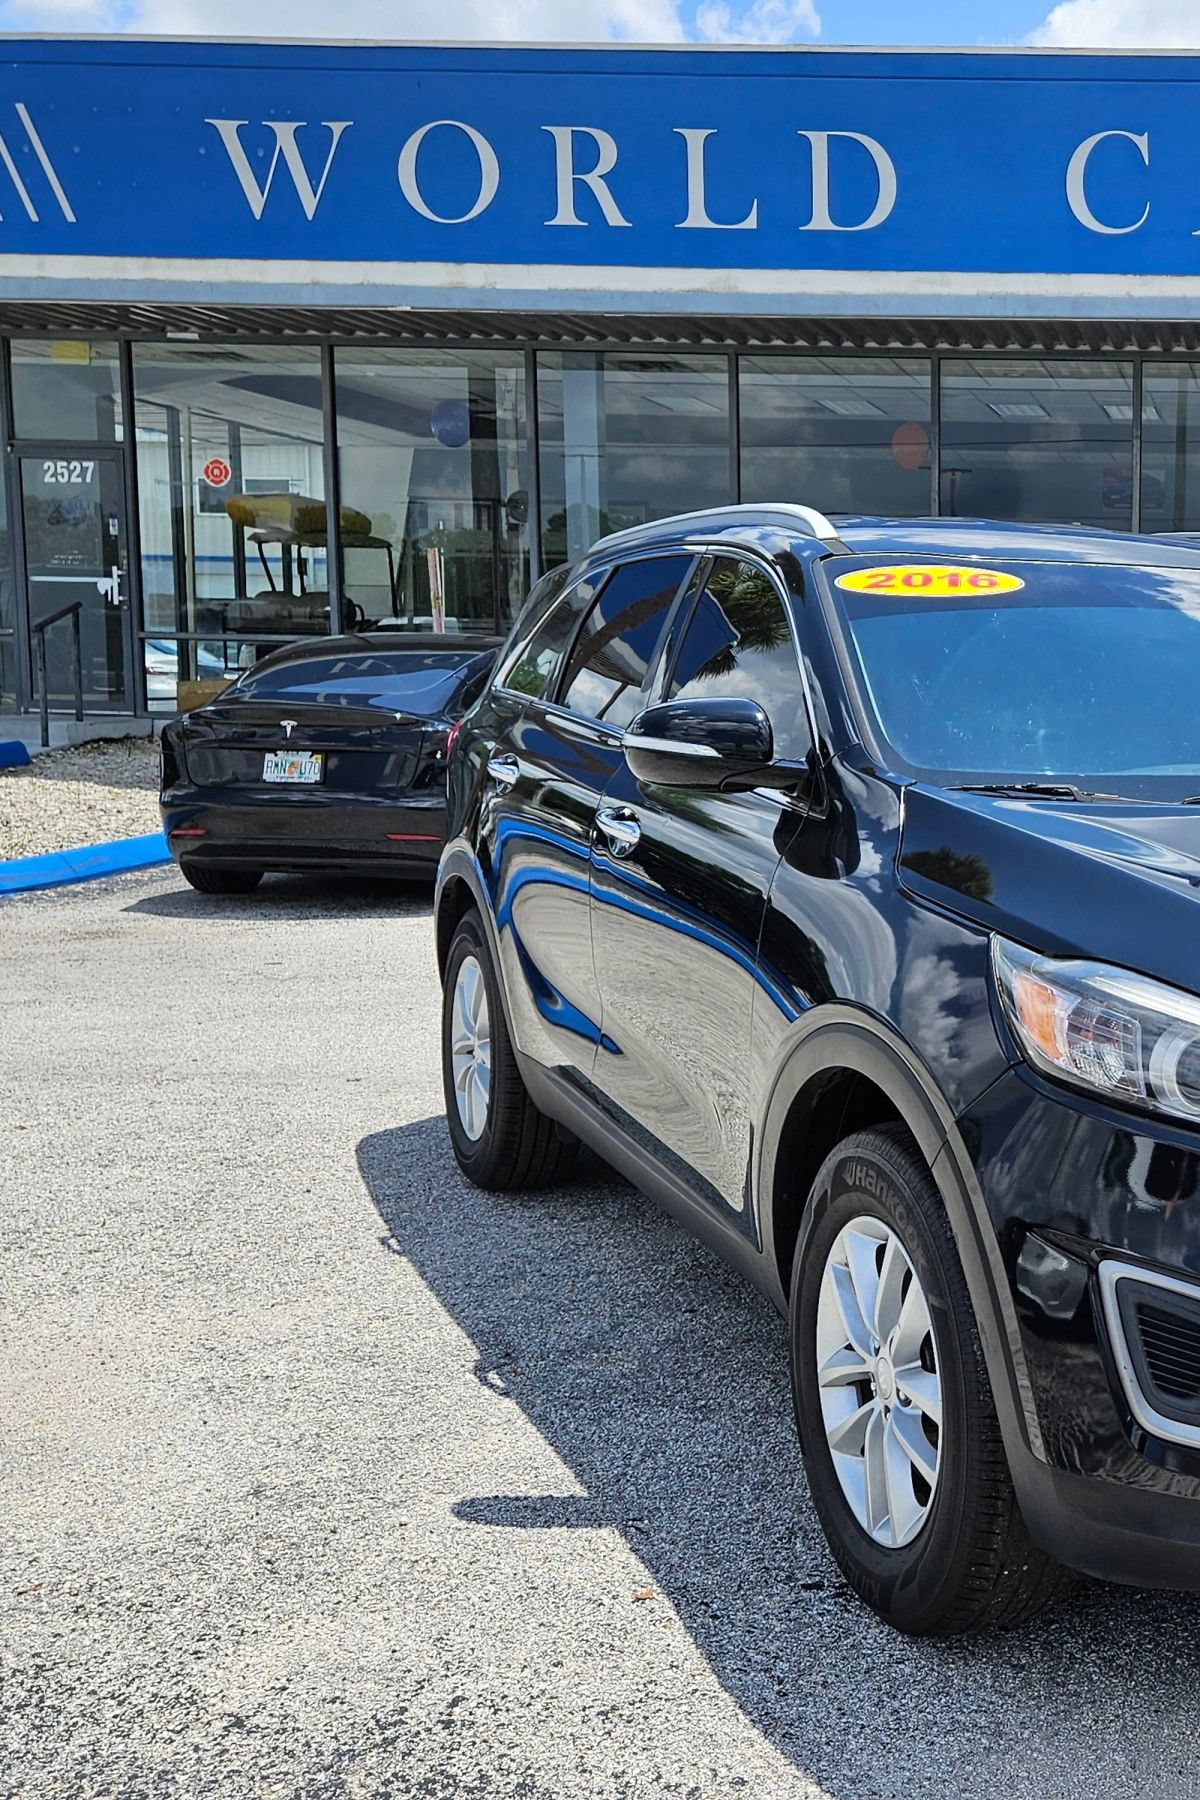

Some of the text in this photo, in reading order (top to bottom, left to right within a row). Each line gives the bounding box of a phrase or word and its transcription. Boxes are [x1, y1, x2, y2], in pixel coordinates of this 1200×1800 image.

[204, 117, 897, 232] WORLD
[43, 461, 94, 483] 2527
[863, 572, 998, 590] 2016
